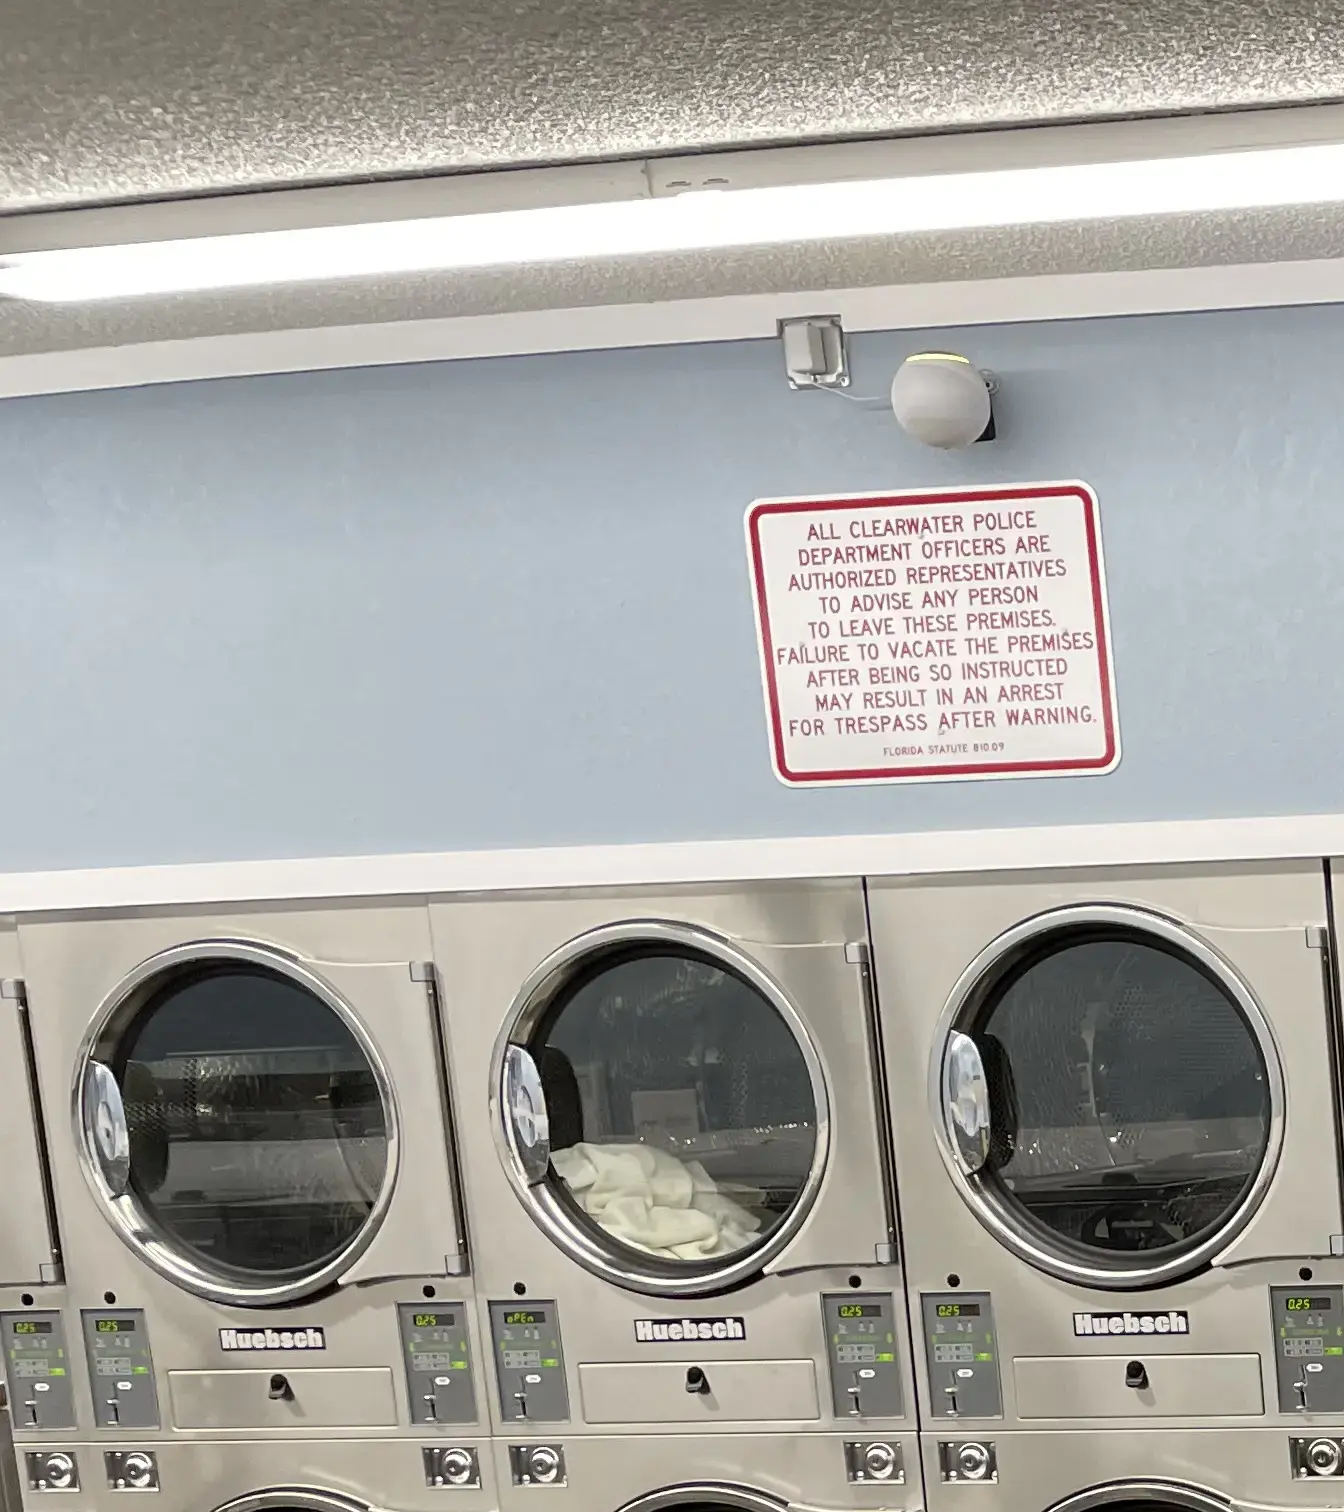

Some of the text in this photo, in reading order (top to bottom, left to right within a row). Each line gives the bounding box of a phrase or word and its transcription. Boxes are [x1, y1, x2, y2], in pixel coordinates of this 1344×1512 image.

[807, 511, 1036, 541] ALL CLEARWATER POLICE
[799, 536, 1051, 566] DEPARTMENT OFFICERS ARE
[789, 559, 1066, 591] AUTHORIZED REPRESENTATIVES
[820, 586, 1038, 614] TO ADVISE ANY PERSON
[808, 610, 1056, 639] TO LEAVE THESE PREMISES.
[778, 632, 1094, 665] FAILURE TO VACATE THE PREMISES
[807, 658, 1067, 688] AFTER BEING SO INSTRUCTED
[816, 683, 1064, 711] MAY RESULT IN AN ARREST
[789, 706, 1097, 736] FOR TRESPASS AFTER WARNING.
[884, 746, 924, 756] FLORIDA
[928, 744, 968, 754] STATUTE
[636, 1319, 743, 1341] Huebsch
[1074, 1312, 1187, 1334] Huebsch
[220, 1329, 324, 1349] Huebsch
